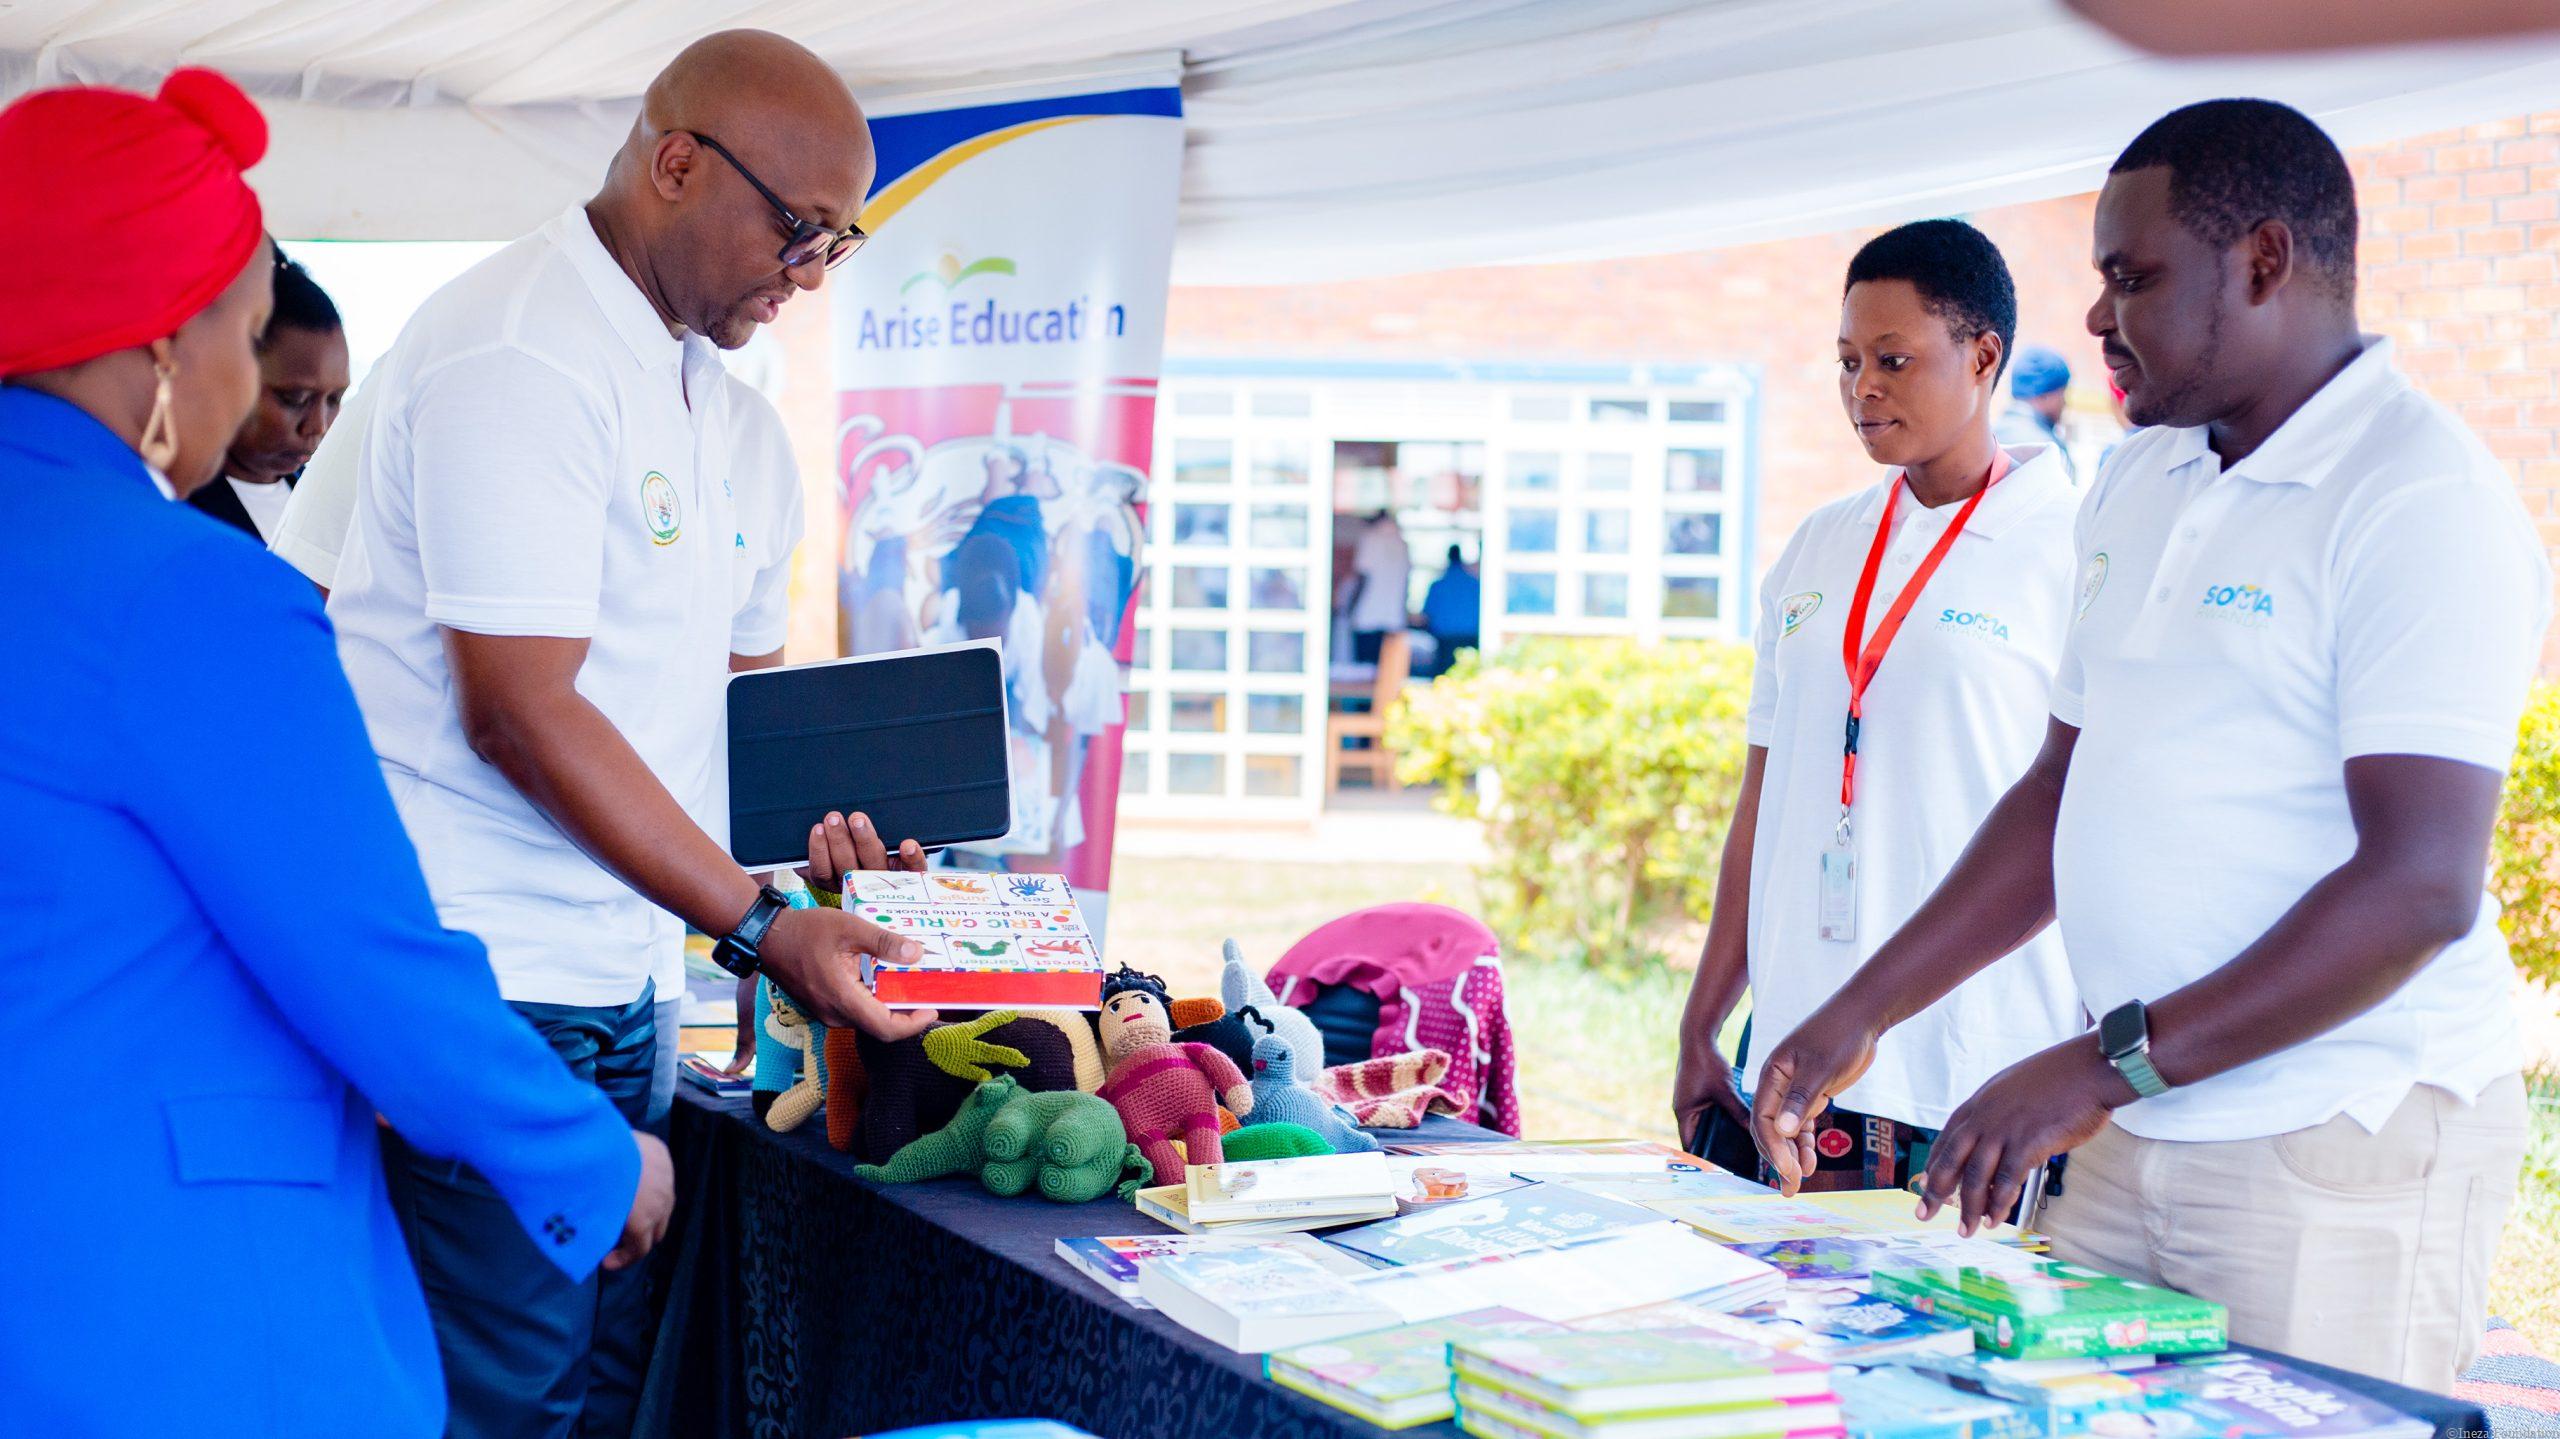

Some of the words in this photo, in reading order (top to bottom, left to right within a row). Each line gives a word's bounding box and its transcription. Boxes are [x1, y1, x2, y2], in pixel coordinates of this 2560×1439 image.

[857, 307, 942, 350] Arise
[949, 294, 1127, 346] Educatin
[2202, 584, 2273, 617] SOMA
[1938, 609, 2009, 641] SOMA
[876, 893, 915, 902] Pond
[938, 894, 990, 902] Jungle
[899, 917, 978, 928] CARLE
[986, 918, 1043, 929] ERIC
